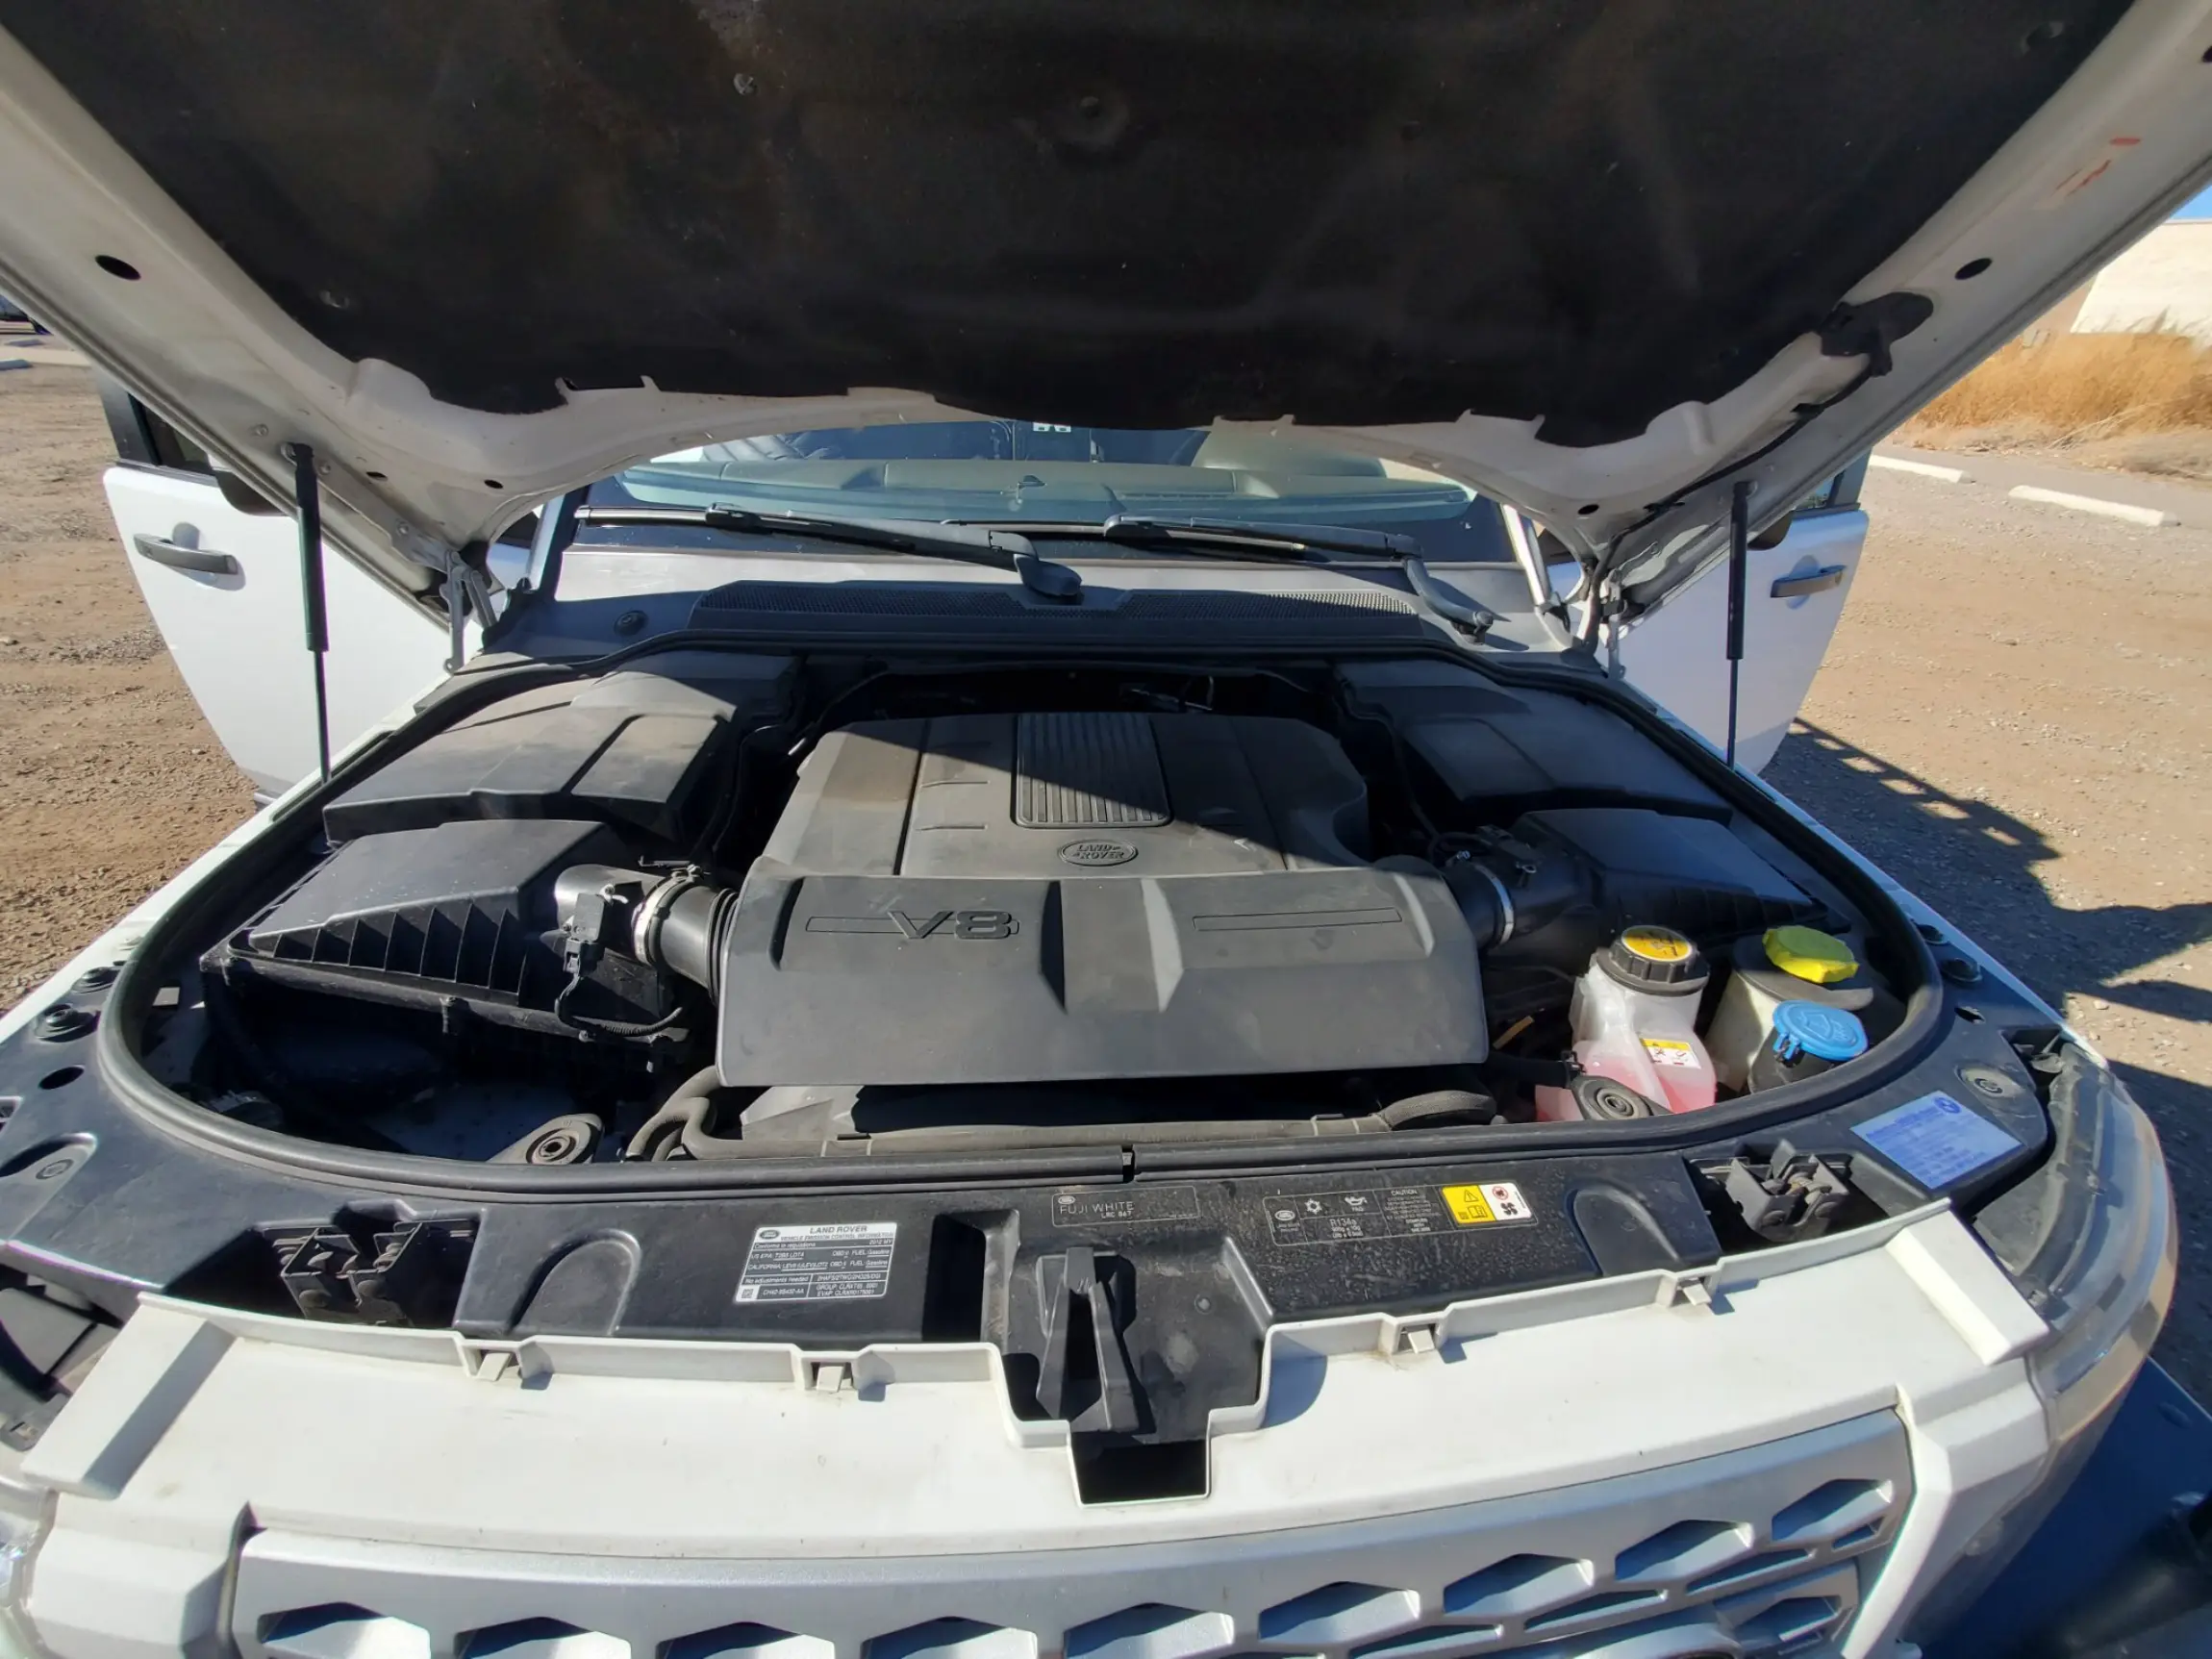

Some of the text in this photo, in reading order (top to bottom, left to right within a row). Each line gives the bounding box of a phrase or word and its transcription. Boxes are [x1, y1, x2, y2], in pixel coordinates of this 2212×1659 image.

[1079, 851, 1124, 860] ROVER
[887, 910, 1012, 940] V8
[1060, 1201, 1134, 1215] FUJI WHITE
[1329, 1219, 1357, 1227] R134a
